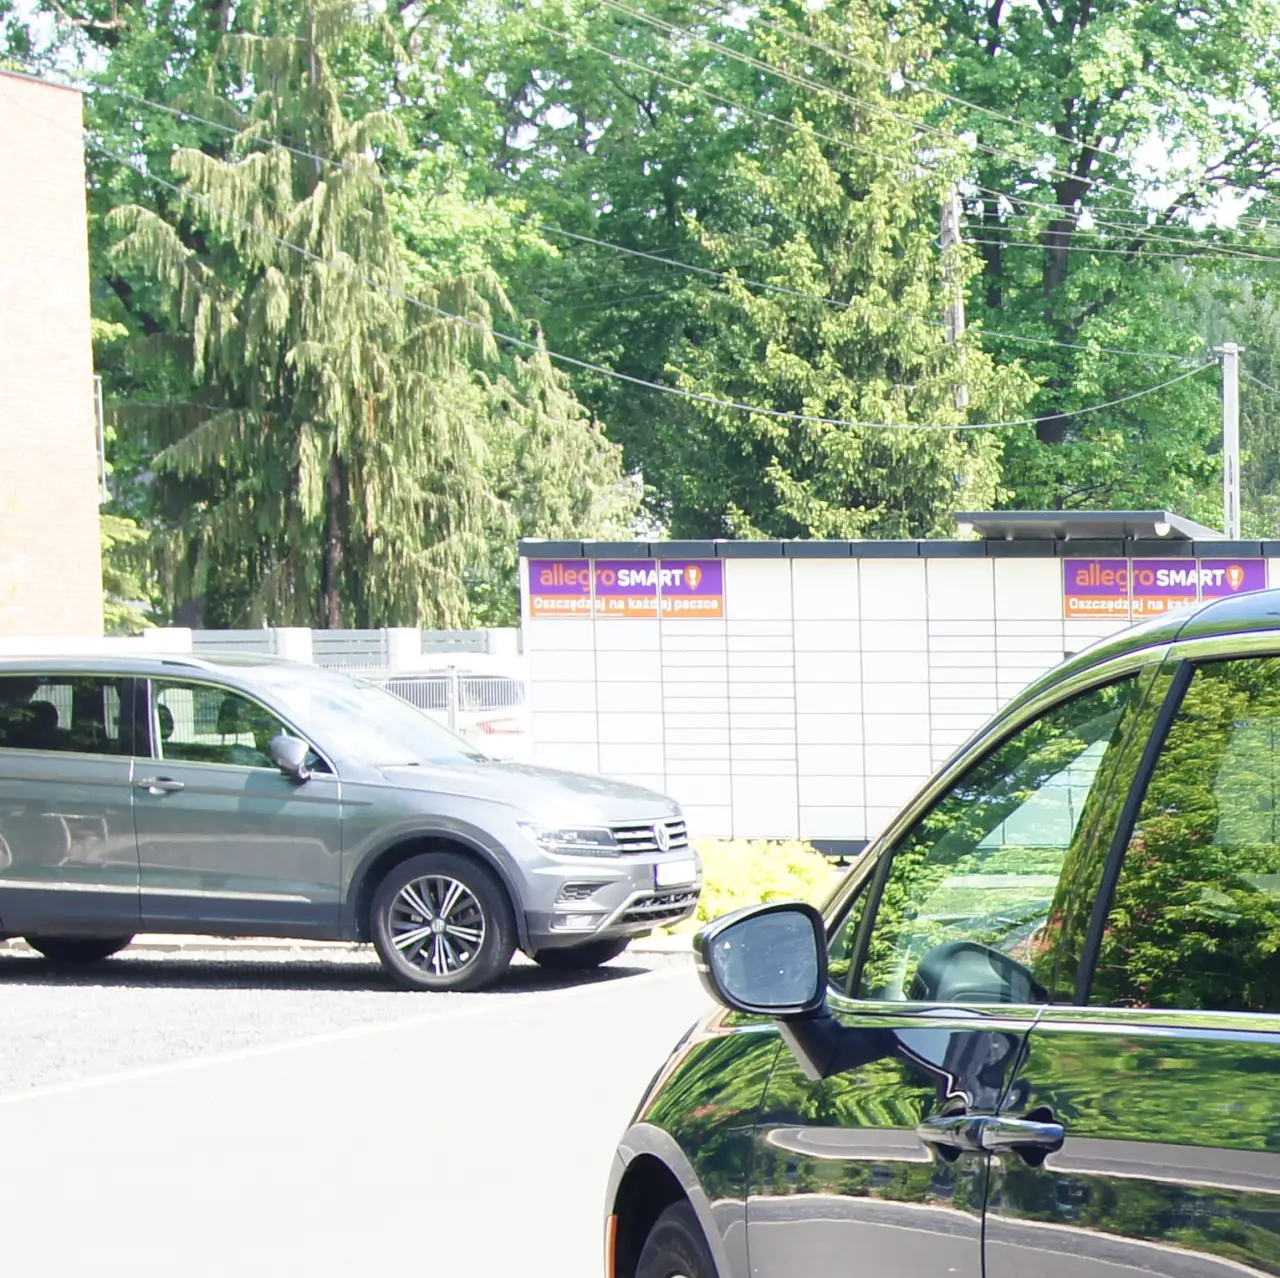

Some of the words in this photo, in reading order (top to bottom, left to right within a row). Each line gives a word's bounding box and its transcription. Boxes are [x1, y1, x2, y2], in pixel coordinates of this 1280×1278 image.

[540, 563, 615, 591] allegro
[1076, 563, 1154, 591] allegro
[609, 599, 625, 610] na
[1147, 599, 1164, 610] na
